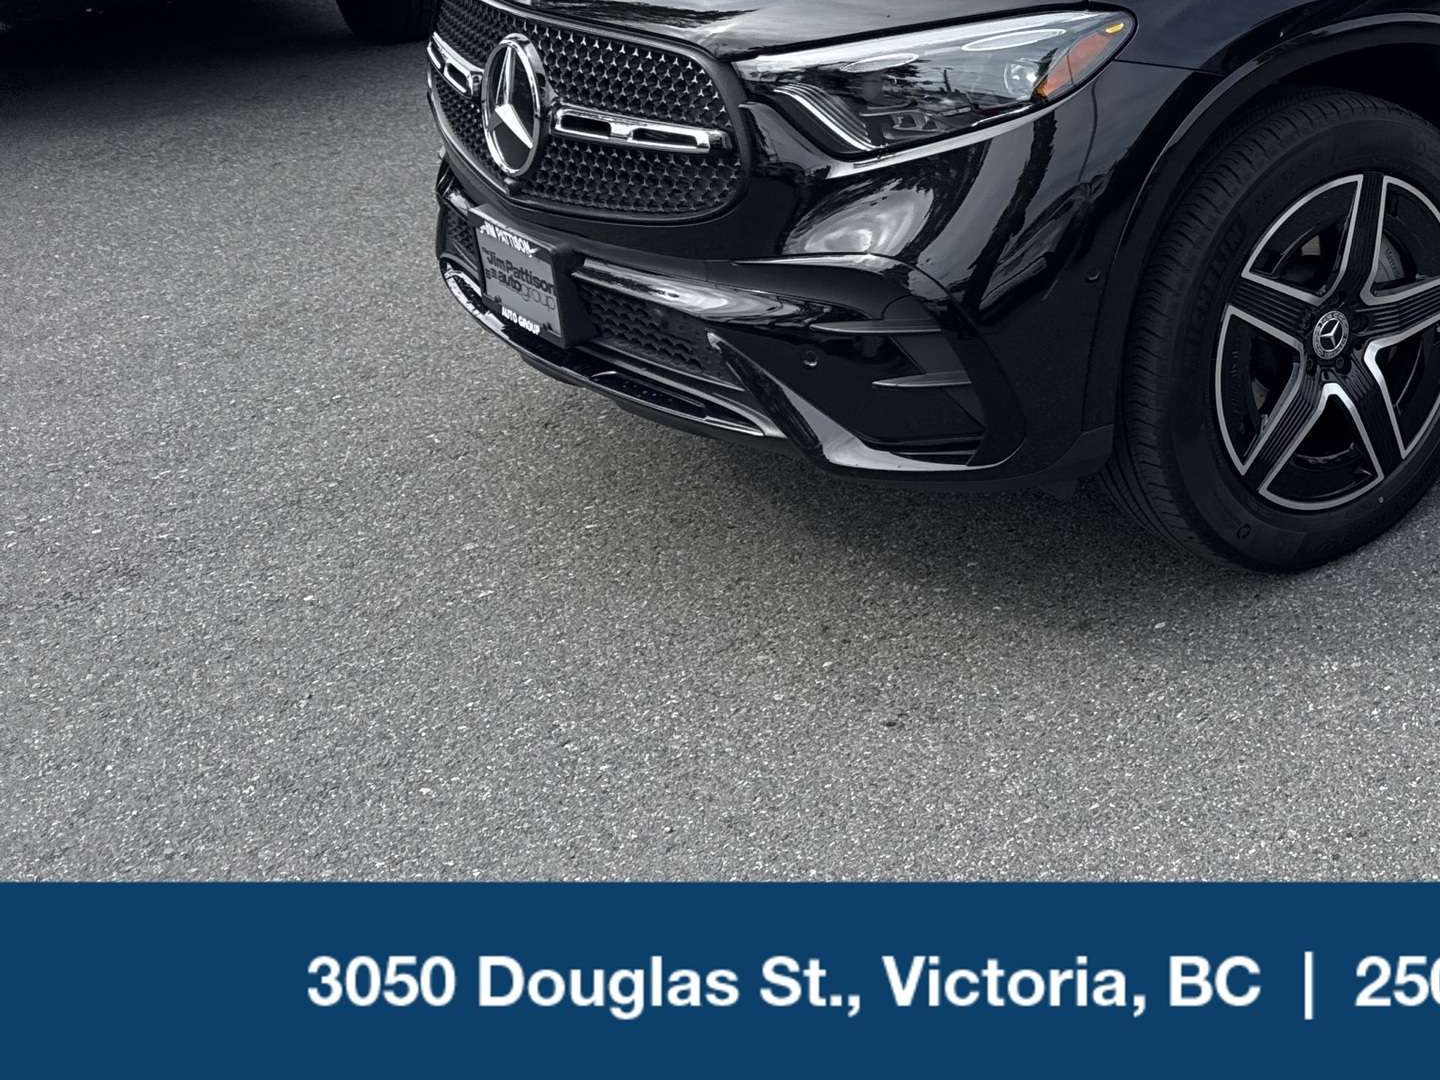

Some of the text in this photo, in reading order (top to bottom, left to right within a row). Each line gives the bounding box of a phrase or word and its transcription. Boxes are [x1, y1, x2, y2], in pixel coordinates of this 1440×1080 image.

[497, 227, 531, 255] PATTISON
[501, 306, 540, 335] AUTO GROUP
